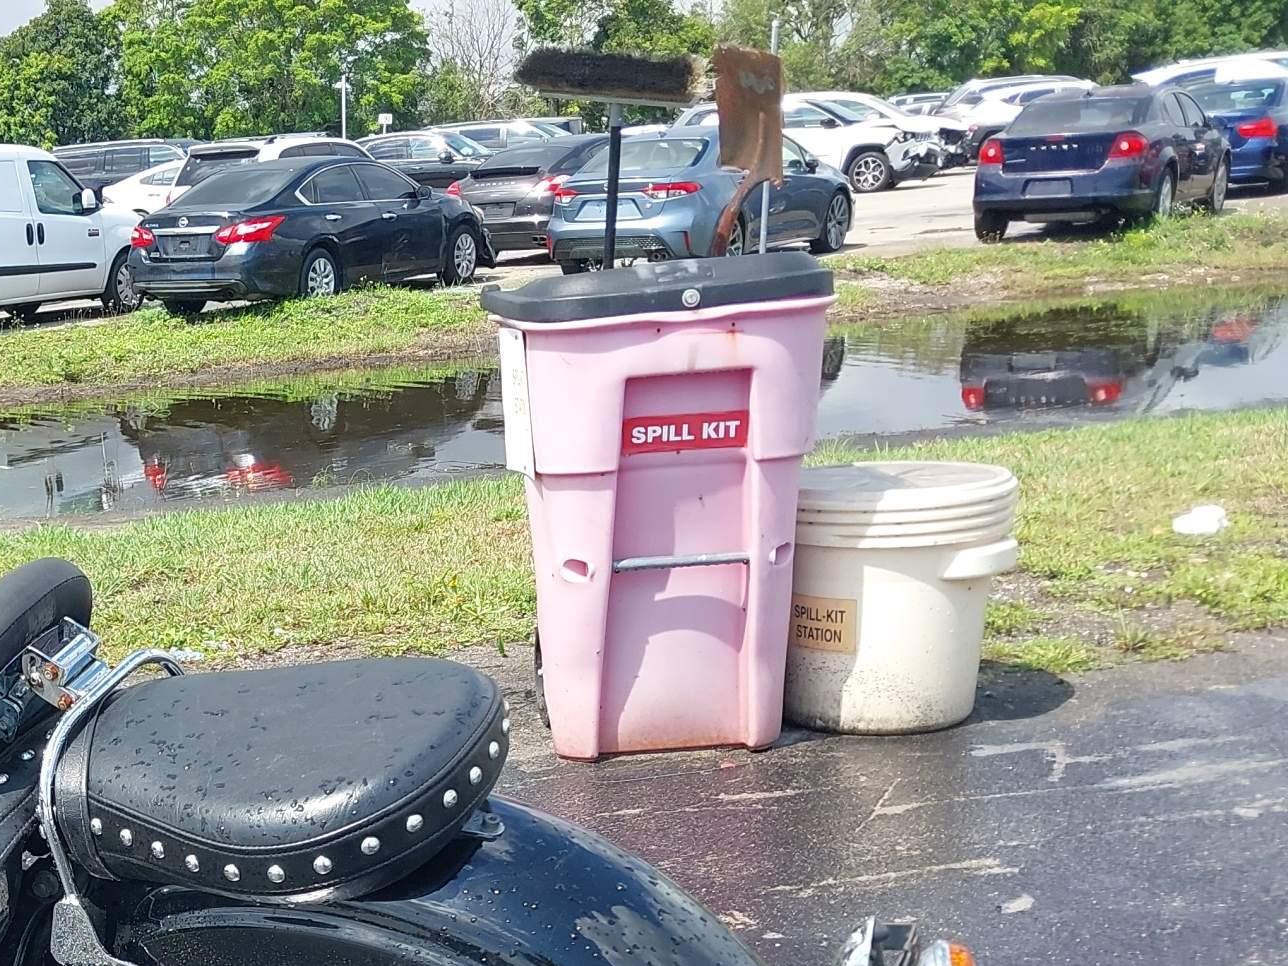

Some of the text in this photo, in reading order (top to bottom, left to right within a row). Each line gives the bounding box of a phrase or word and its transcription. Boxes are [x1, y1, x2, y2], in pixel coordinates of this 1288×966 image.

[631, 420, 741, 444] SPILL KIT
[794, 604, 847, 624] SPILL-KIT
[796, 624, 843, 643] STATION
